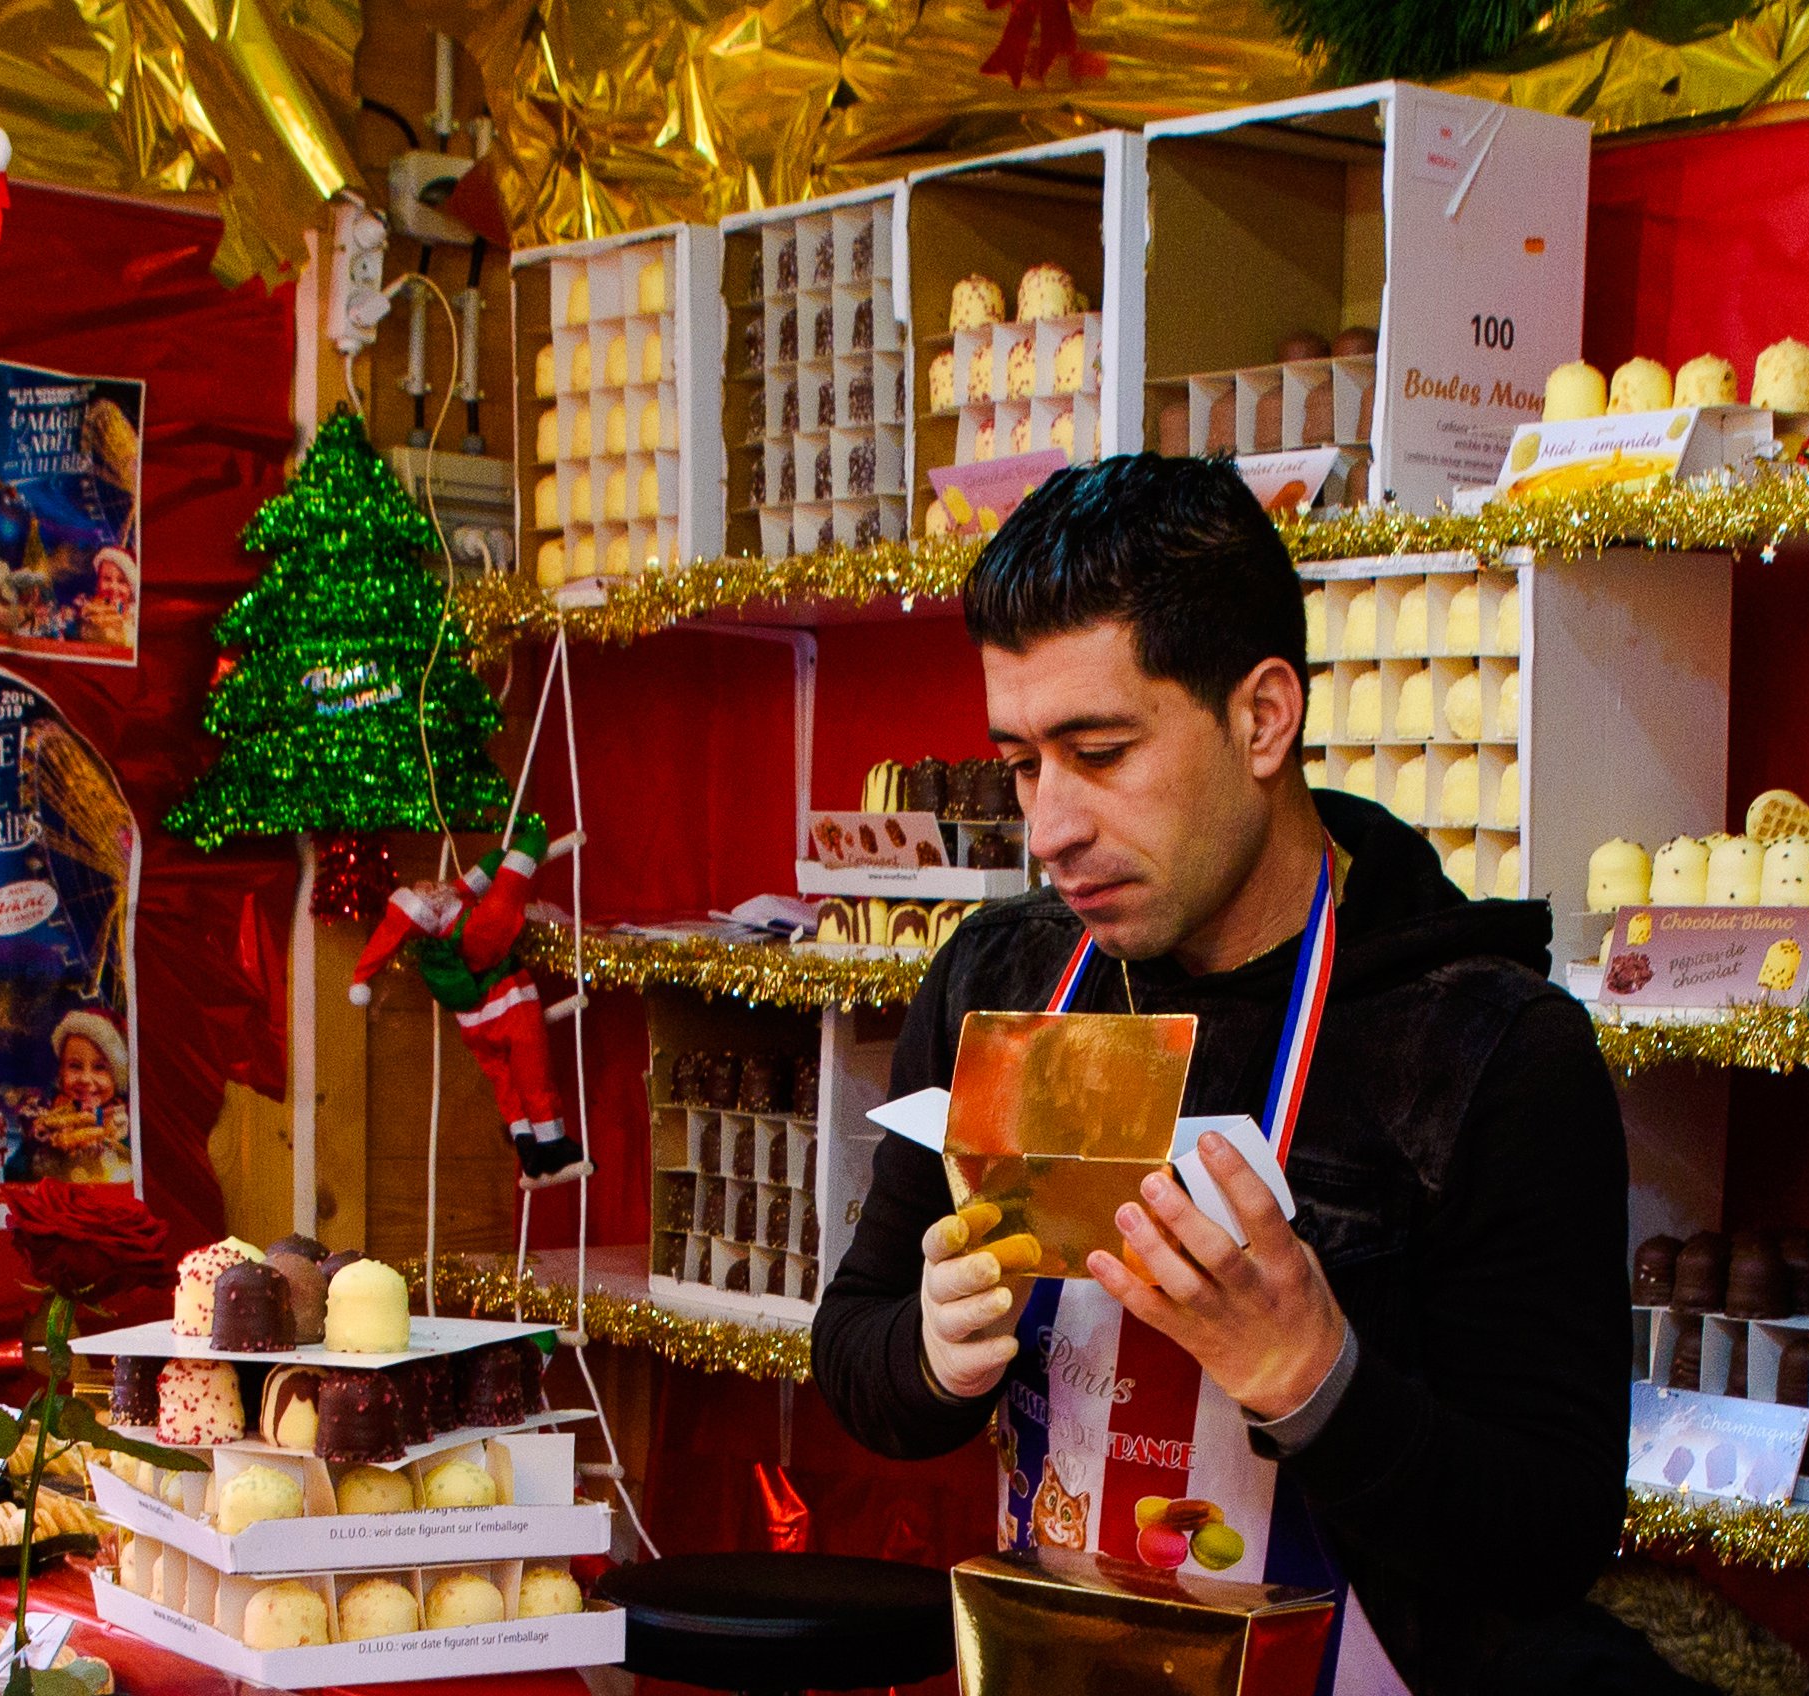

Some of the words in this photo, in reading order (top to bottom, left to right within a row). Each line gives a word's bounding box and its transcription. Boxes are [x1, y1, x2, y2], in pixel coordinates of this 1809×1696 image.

[1471, 313, 1514, 351] 100
[1403, 367, 1481, 408] Boules
[1540, 440, 1576, 460] Miel
[1589, 432, 1664, 453] amandes
[1660, 911, 1738, 931] Chocolat
[1741, 911, 1796, 931] Blanc
[1725, 942, 1748, 959] de
[1673, 962, 1743, 990] chocolat
[1037, 1325, 1136, 1404] Paris
[1701, 1413, 1803, 1445] Champagne
[1106, 1431, 1196, 1470] FRANCE
[374, 1526, 392, 1538] voir
[394, 1524, 417, 1536] date
[419, 1522, 456, 1538] figurant
[458, 1522, 472, 1533] sur
[475, 1520, 530, 1533] l'emballage
[401, 1640, 418, 1651] voir
[420, 1637, 441, 1650] date
[444, 1635, 480, 1650] figurant
[482, 1635, 497, 1645] sur
[498, 1630, 550, 1645] l'emballage
